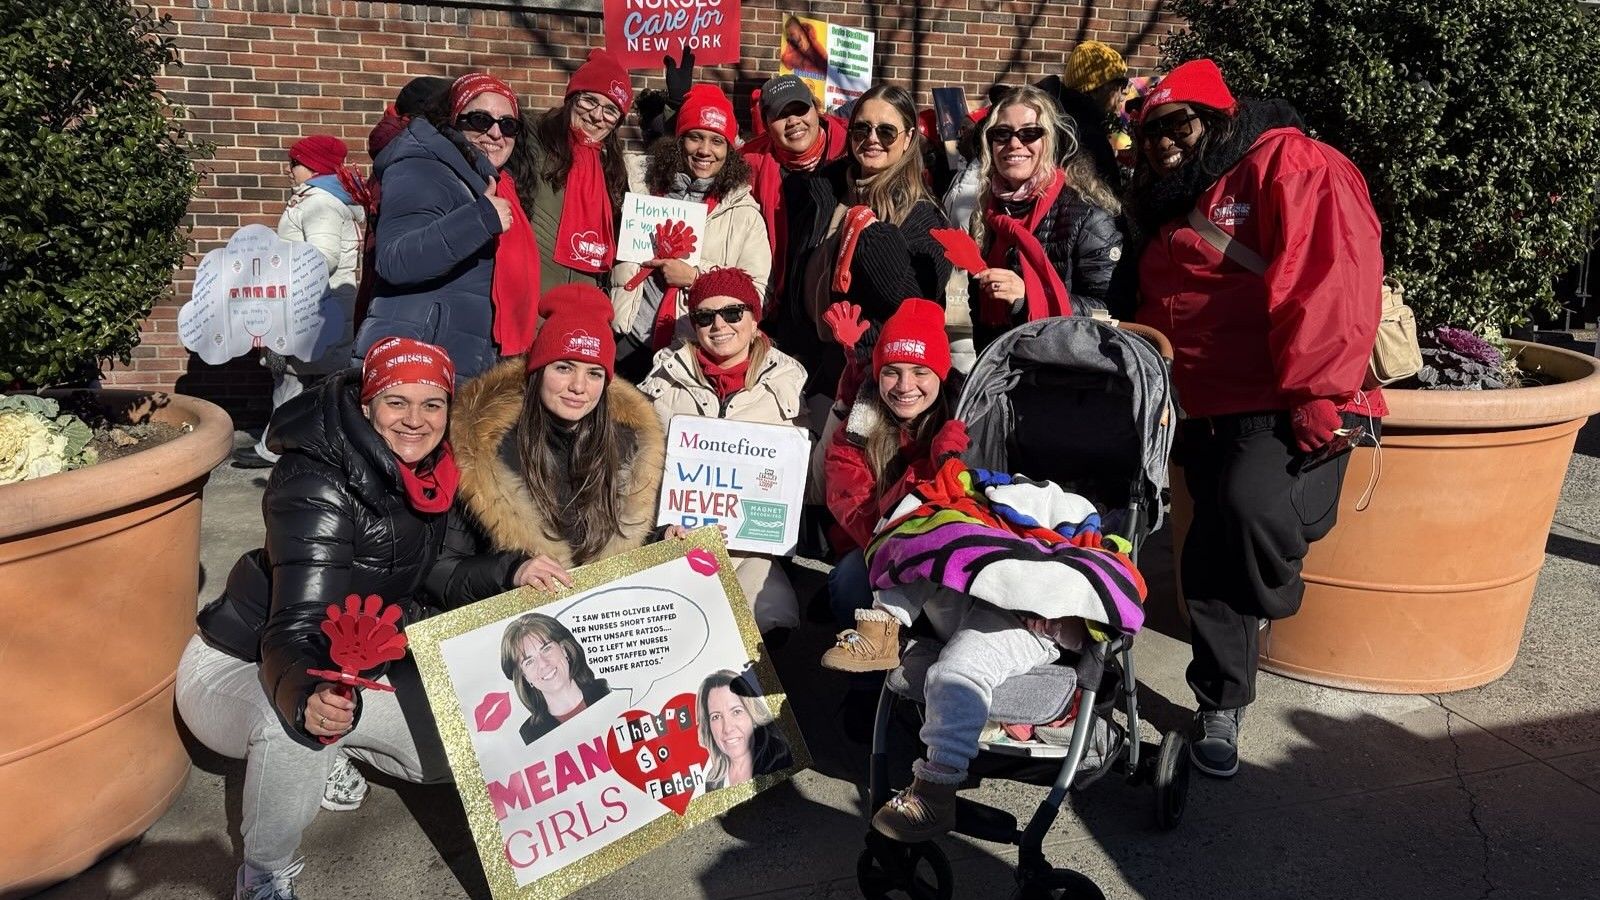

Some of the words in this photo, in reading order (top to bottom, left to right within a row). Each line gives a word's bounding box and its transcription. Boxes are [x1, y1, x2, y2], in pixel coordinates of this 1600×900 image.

[623, 9, 690, 39] Care
[691, 6, 723, 36] for
[627, 37, 669, 52] NEW
[678, 34, 722, 50] YORK
[640, 222, 656, 234] you
[632, 238, 652, 250] Nur
[386, 353, 433, 368] NURSES
[679, 431, 777, 459] Montefiore
[676, 462, 743, 490] WILL
[668, 489, 739, 519] NEVER
[750, 505, 782, 514] MAGNET
[583, 613, 599, 622] SAW
[601, 610, 620, 620] BETH
[622, 606, 651, 617] OLIVER
[652, 603, 674, 612] LEAVE
[572, 625, 586, 634] HER
[588, 621, 618, 632] NURSES
[620, 618, 645, 628] SHORT
[647, 613, 677, 624] STAFFED
[581, 635, 602, 644] WITH
[603, 630, 634, 641] UNSAFE
[587, 646, 598, 654] SO
[600, 644, 605, 652] I
[606, 642, 624, 651] LEFT
[626, 640, 638, 648] MY
[639, 635, 668, 646] NURSES
[588, 655, 613, 665] SHORT
[615, 650, 647, 661] STAFFED
[649, 646, 670, 655] WITH
[599, 663, 629, 674] UNSAFE
[616, 711, 688, 743] That's
[640, 747, 669, 769] So
[486, 736, 612, 820] MEAN
[649, 769, 704, 799] Fetch
[504, 786, 628, 869] GIRLS
